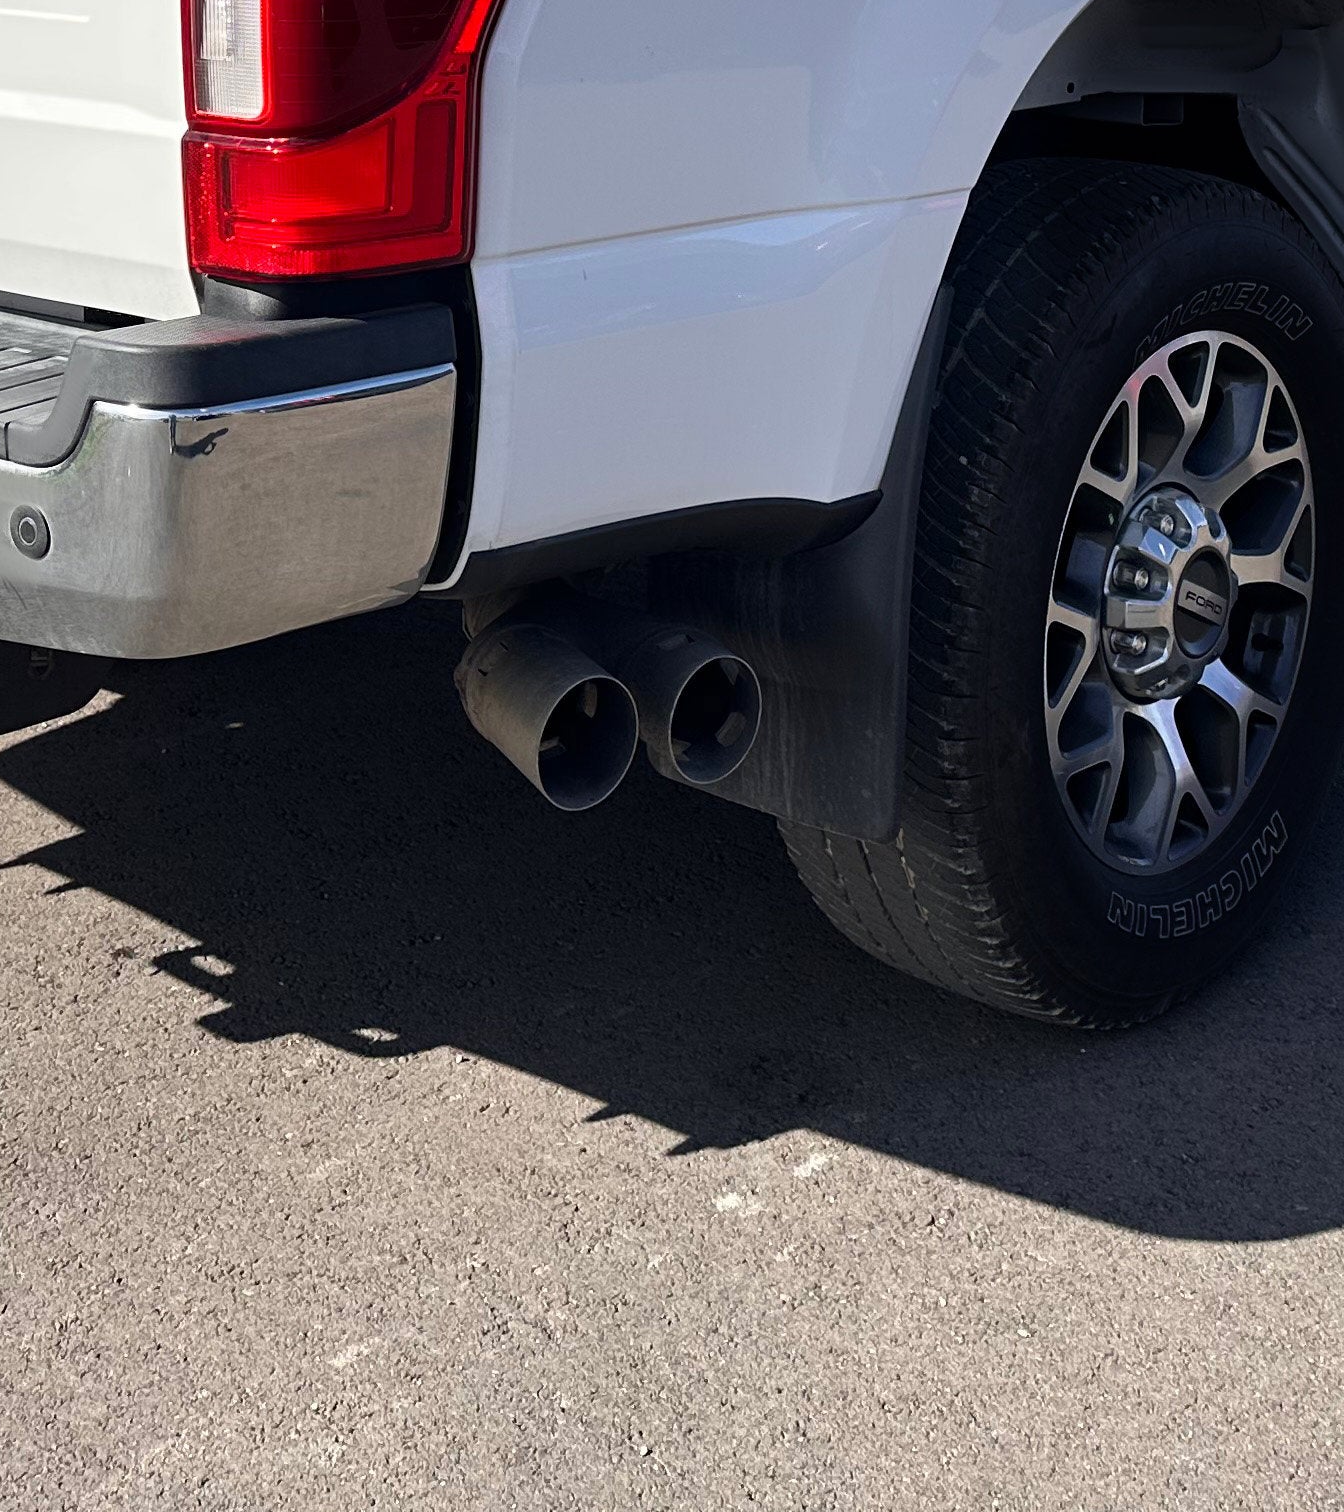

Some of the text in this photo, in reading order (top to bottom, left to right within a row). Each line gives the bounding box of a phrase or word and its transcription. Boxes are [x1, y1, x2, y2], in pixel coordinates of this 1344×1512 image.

[1132, 281, 1314, 370] MICHELIN
[1184, 590, 1224, 616] FORD
[1106, 810, 1289, 939] MICHELIN
